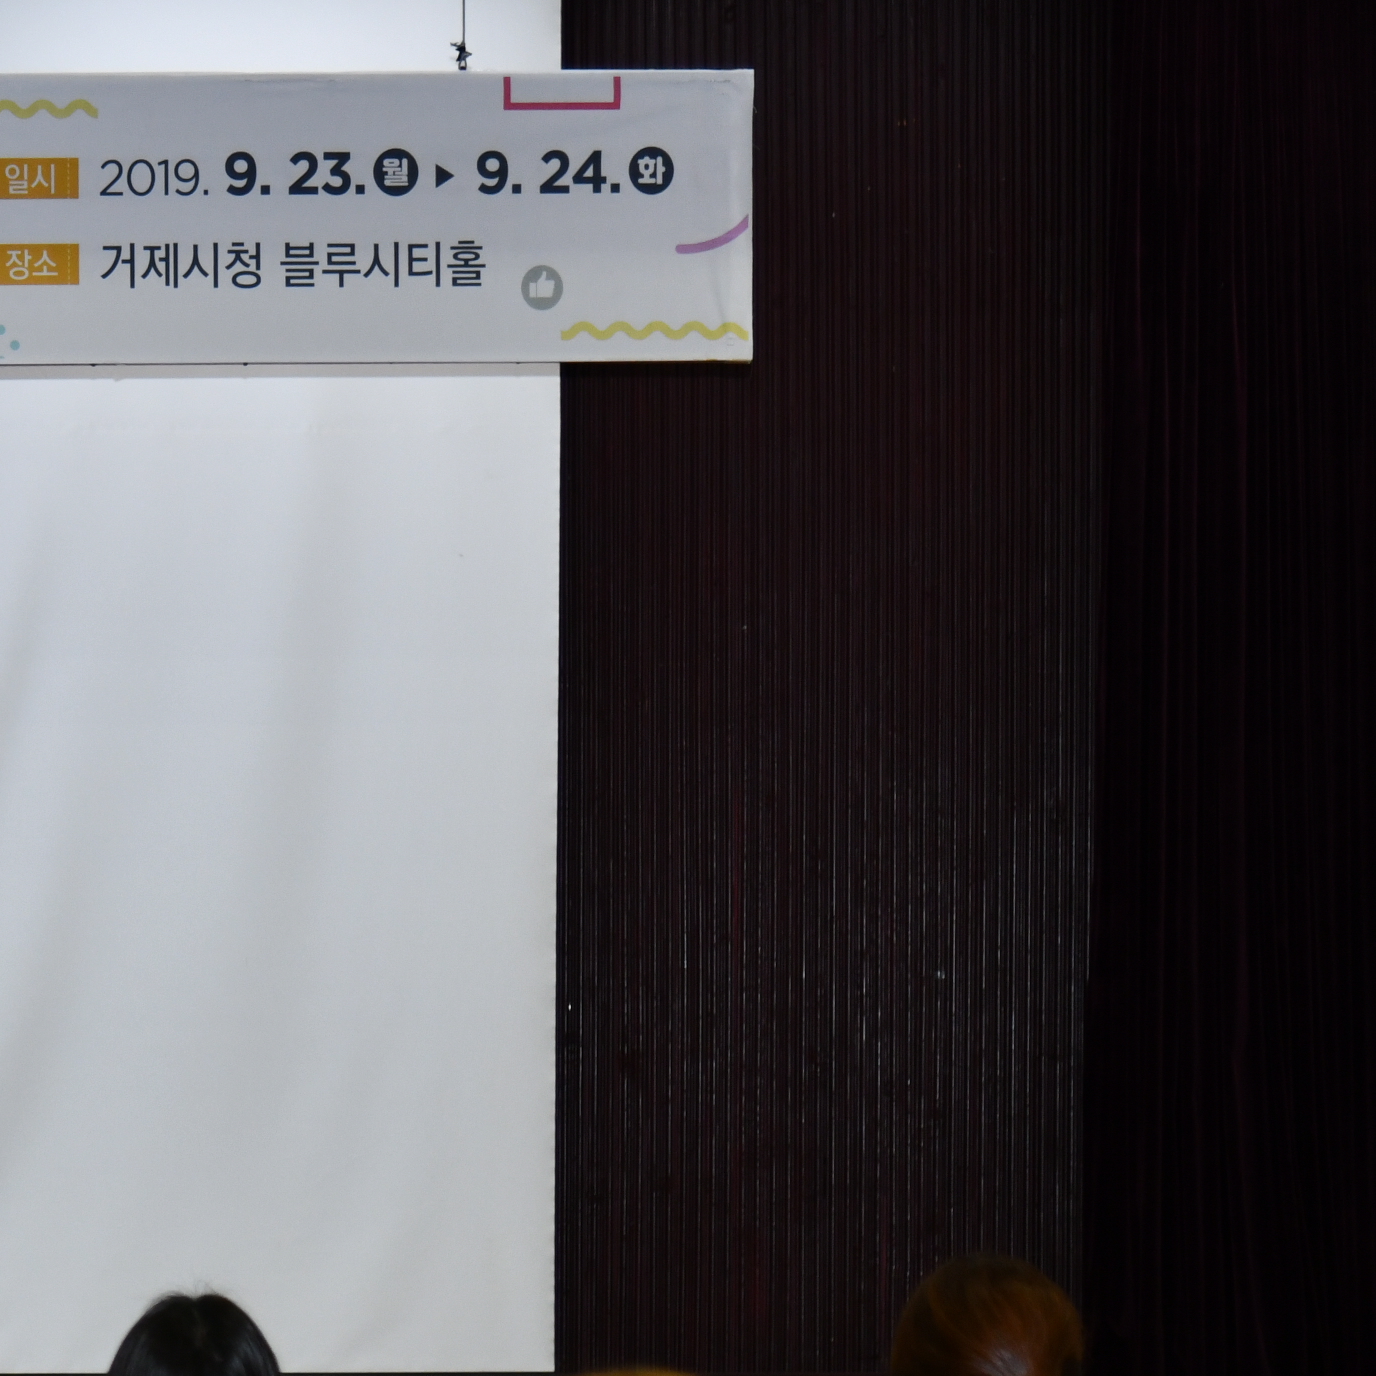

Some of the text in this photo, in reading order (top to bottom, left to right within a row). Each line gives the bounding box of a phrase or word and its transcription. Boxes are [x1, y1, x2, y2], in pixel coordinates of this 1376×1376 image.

[3, 160, 57, 197] 일시
[99, 158, 210, 198] 2019.
[224, 150, 272, 196] 9.
[288, 150, 366, 196] 23.
[476, 148, 523, 195] 9.
[540, 148, 621, 195] 24.
[5, 246, 59, 281] 장소
[100, 238, 487, 290] 거제시청 블루시티홀
